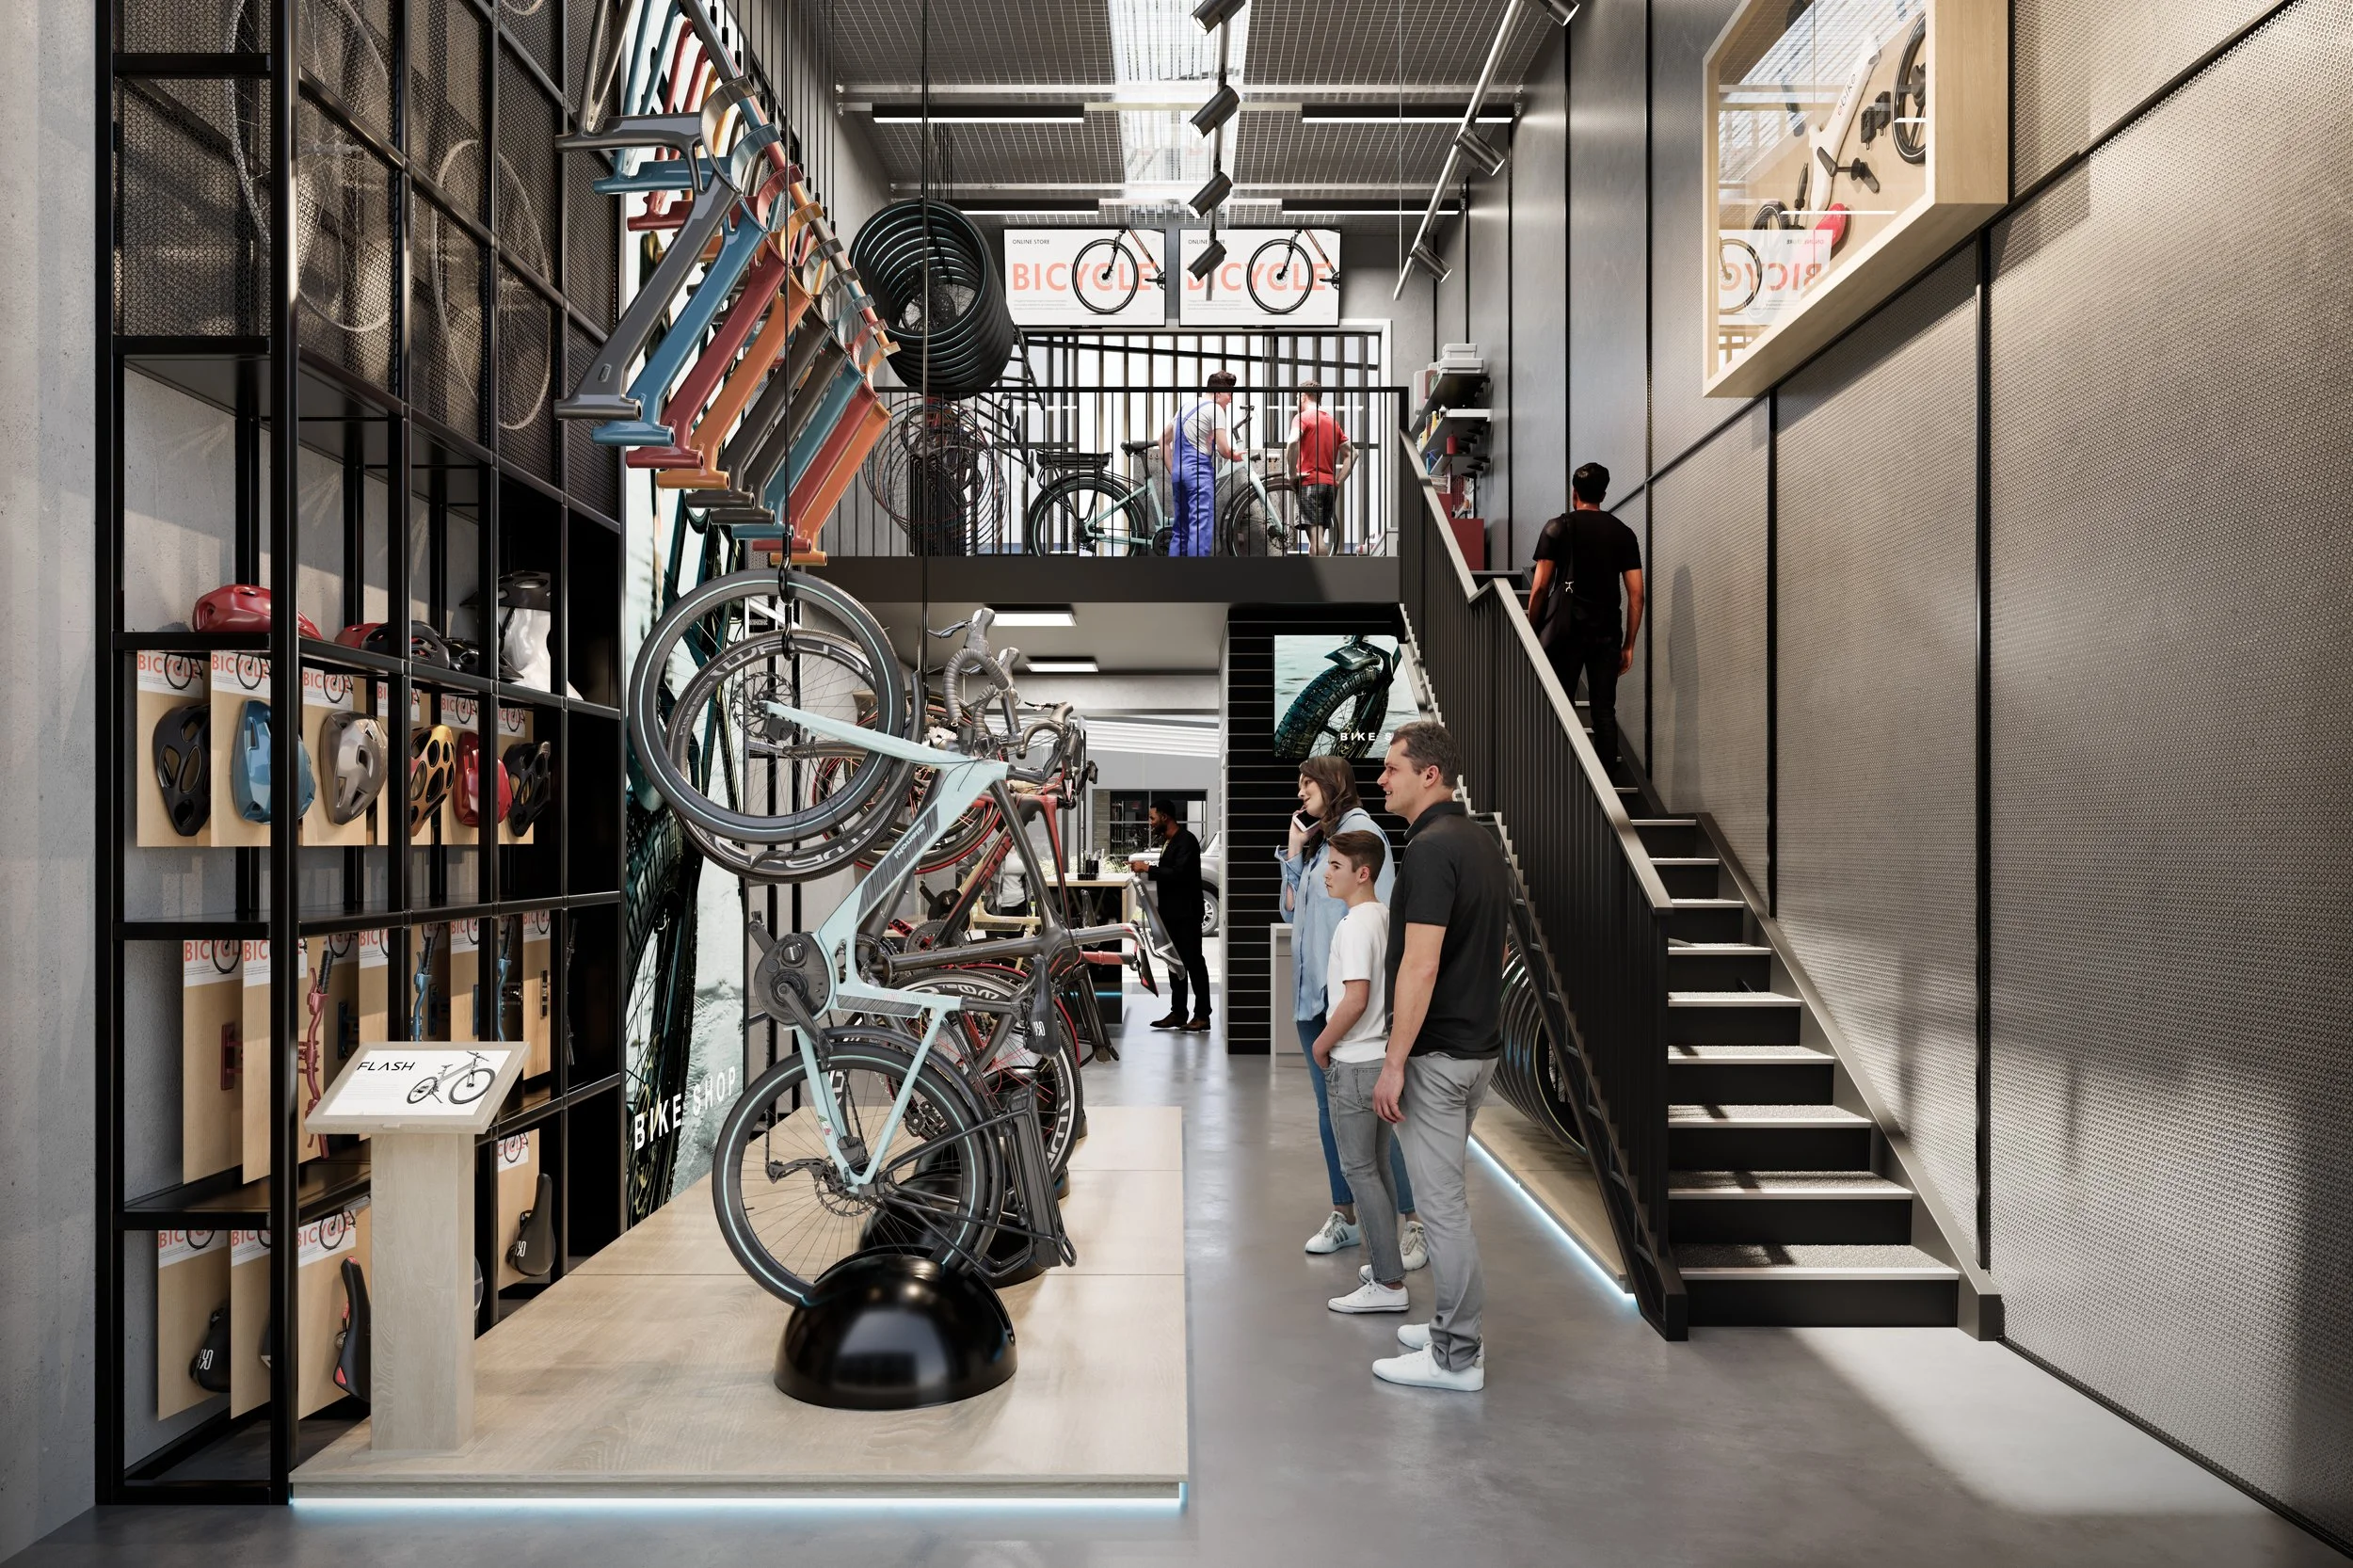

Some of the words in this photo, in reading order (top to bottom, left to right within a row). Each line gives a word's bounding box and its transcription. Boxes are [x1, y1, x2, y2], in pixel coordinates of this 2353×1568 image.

[1013, 263, 1152, 292] BICYCLE
[137, 654, 200, 679] BICYCLE
[212, 654, 268, 679] BICYCLE
[303, 672, 349, 694] BICYCLE
[441, 697, 476, 715] BICYCLE
[1340, 732, 1376, 742] BIKE
[894, 824, 926, 859] Bianchi
[356, 1062, 416, 1071] FLASH
[634, 1093, 681, 1151] BIKE
[693, 1065, 736, 1116] SHOP
